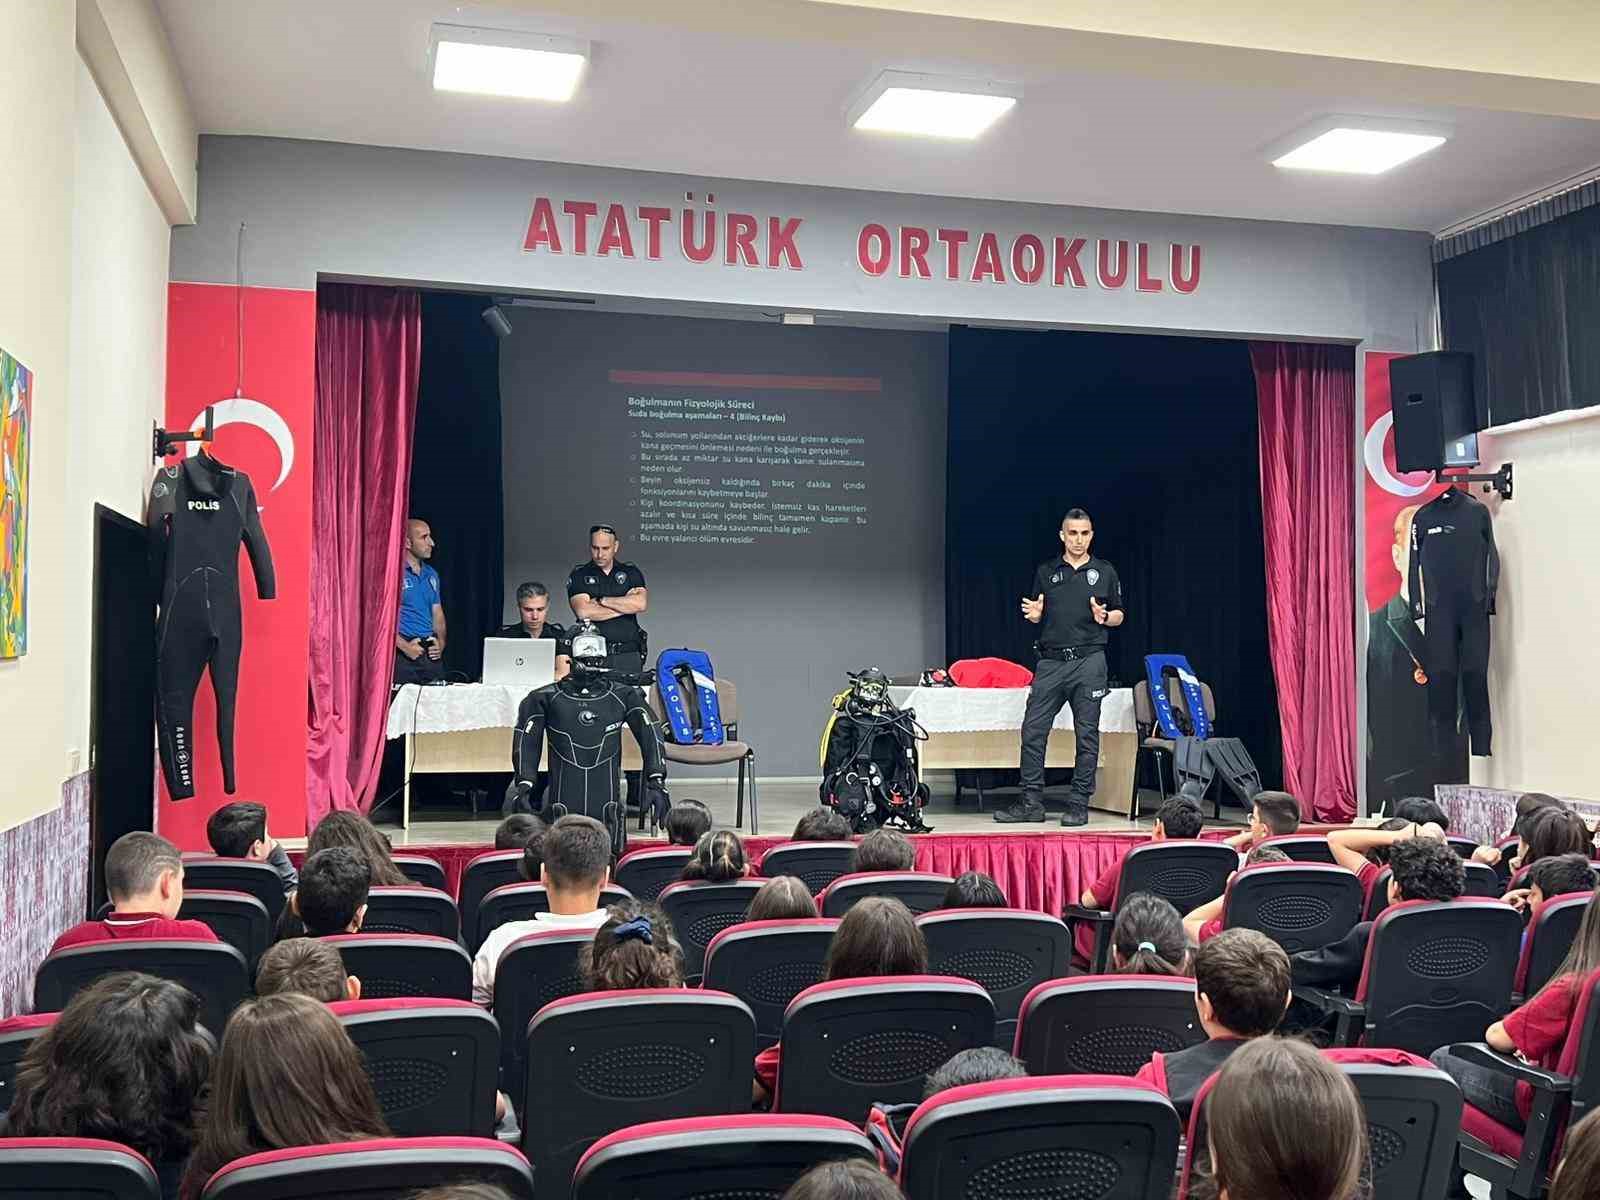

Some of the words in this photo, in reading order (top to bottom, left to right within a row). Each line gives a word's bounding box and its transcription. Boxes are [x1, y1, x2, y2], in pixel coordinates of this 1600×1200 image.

[521, 191, 805, 272] ATATÜRK
[855, 223, 1202, 294] ORTAOKULU
[628, 396, 682, 407] Boğulmanın
[684, 398, 726, 410] Fizyolojik
[727, 400, 754, 409] Süreci
[649, 410, 683, 420] boğulma
[777, 433, 798, 442] kadar
[774, 445, 807, 455] boğulma
[807, 503, 820, 511] kas
[702, 512, 718, 520] süre
[724, 512, 747, 521] içinde
[752, 512, 774, 522] bilinç
[640, 534, 651, 542] Bu
[698, 535, 720, 543] ölüm
